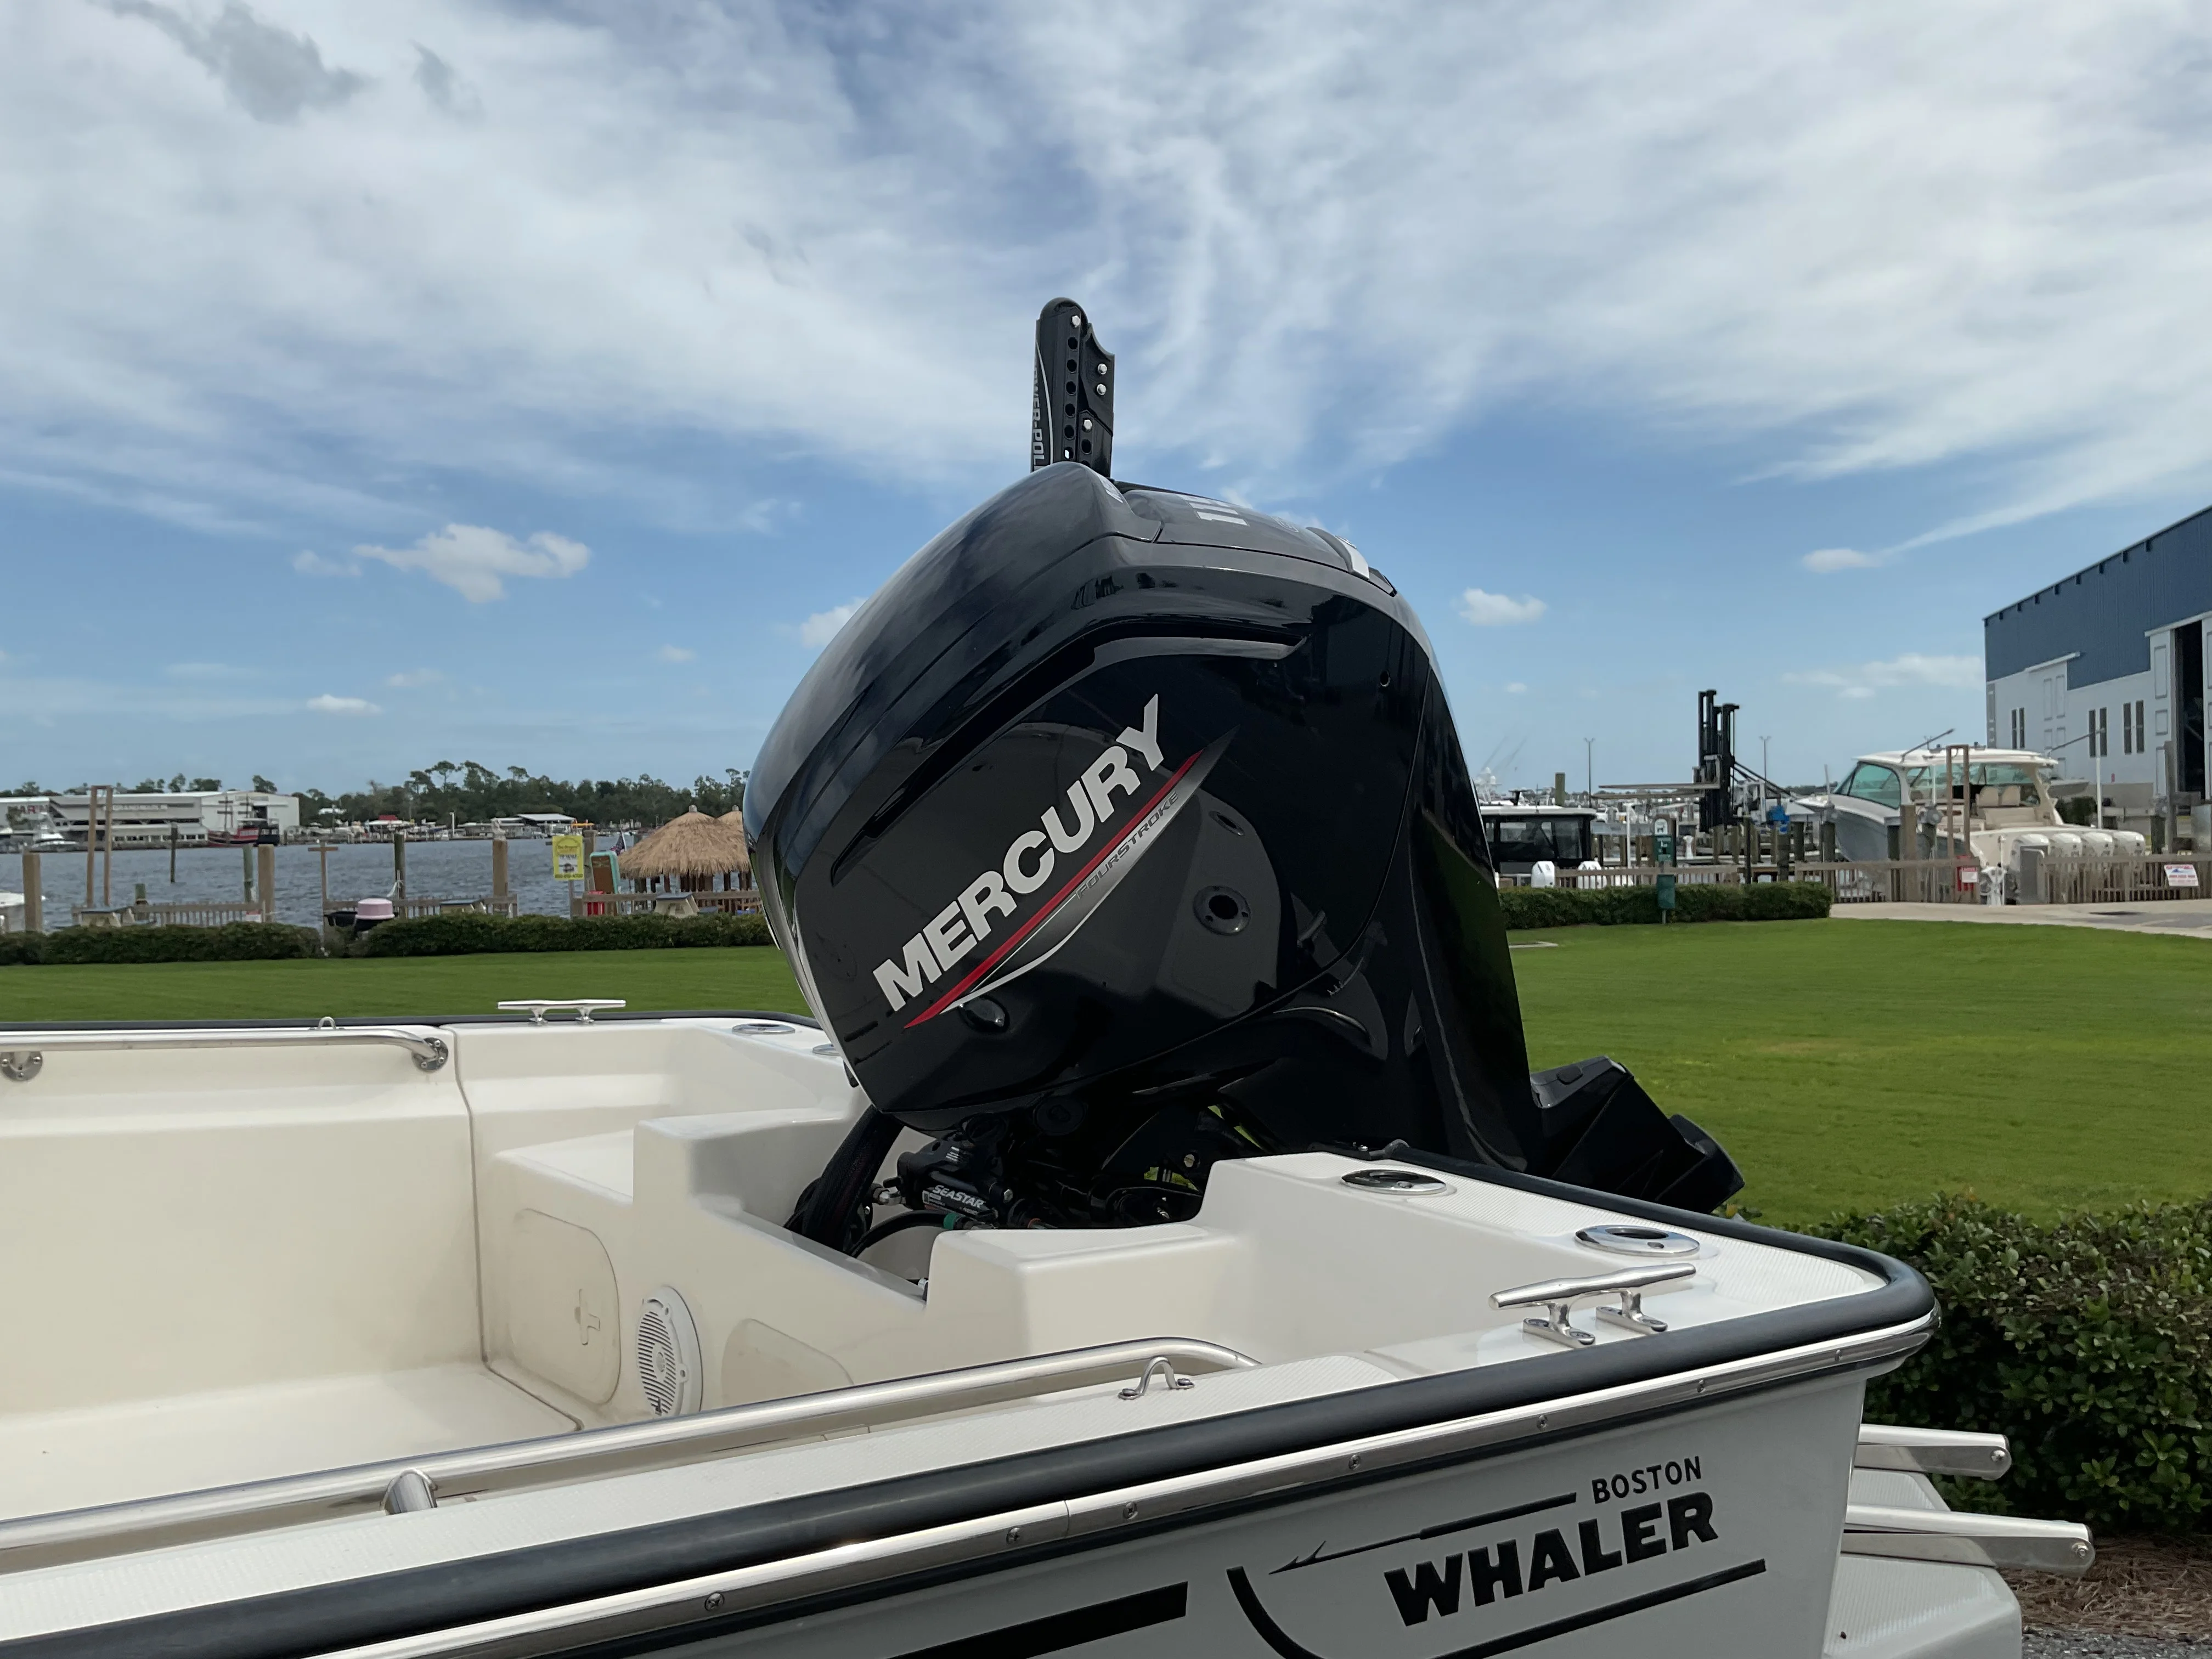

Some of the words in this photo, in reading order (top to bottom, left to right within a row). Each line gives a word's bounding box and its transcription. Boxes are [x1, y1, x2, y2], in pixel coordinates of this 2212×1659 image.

[1032, 354, 1046, 471] WER-POL
[872, 693, 1164, 1012] MERCURY
[1076, 791, 1178, 899] FOURSTROKE
[932, 1184, 984, 1209] SEASTAR
[1592, 1455, 1701, 1504] BOSTON
[1384, 1492, 1719, 1627] WHALER
